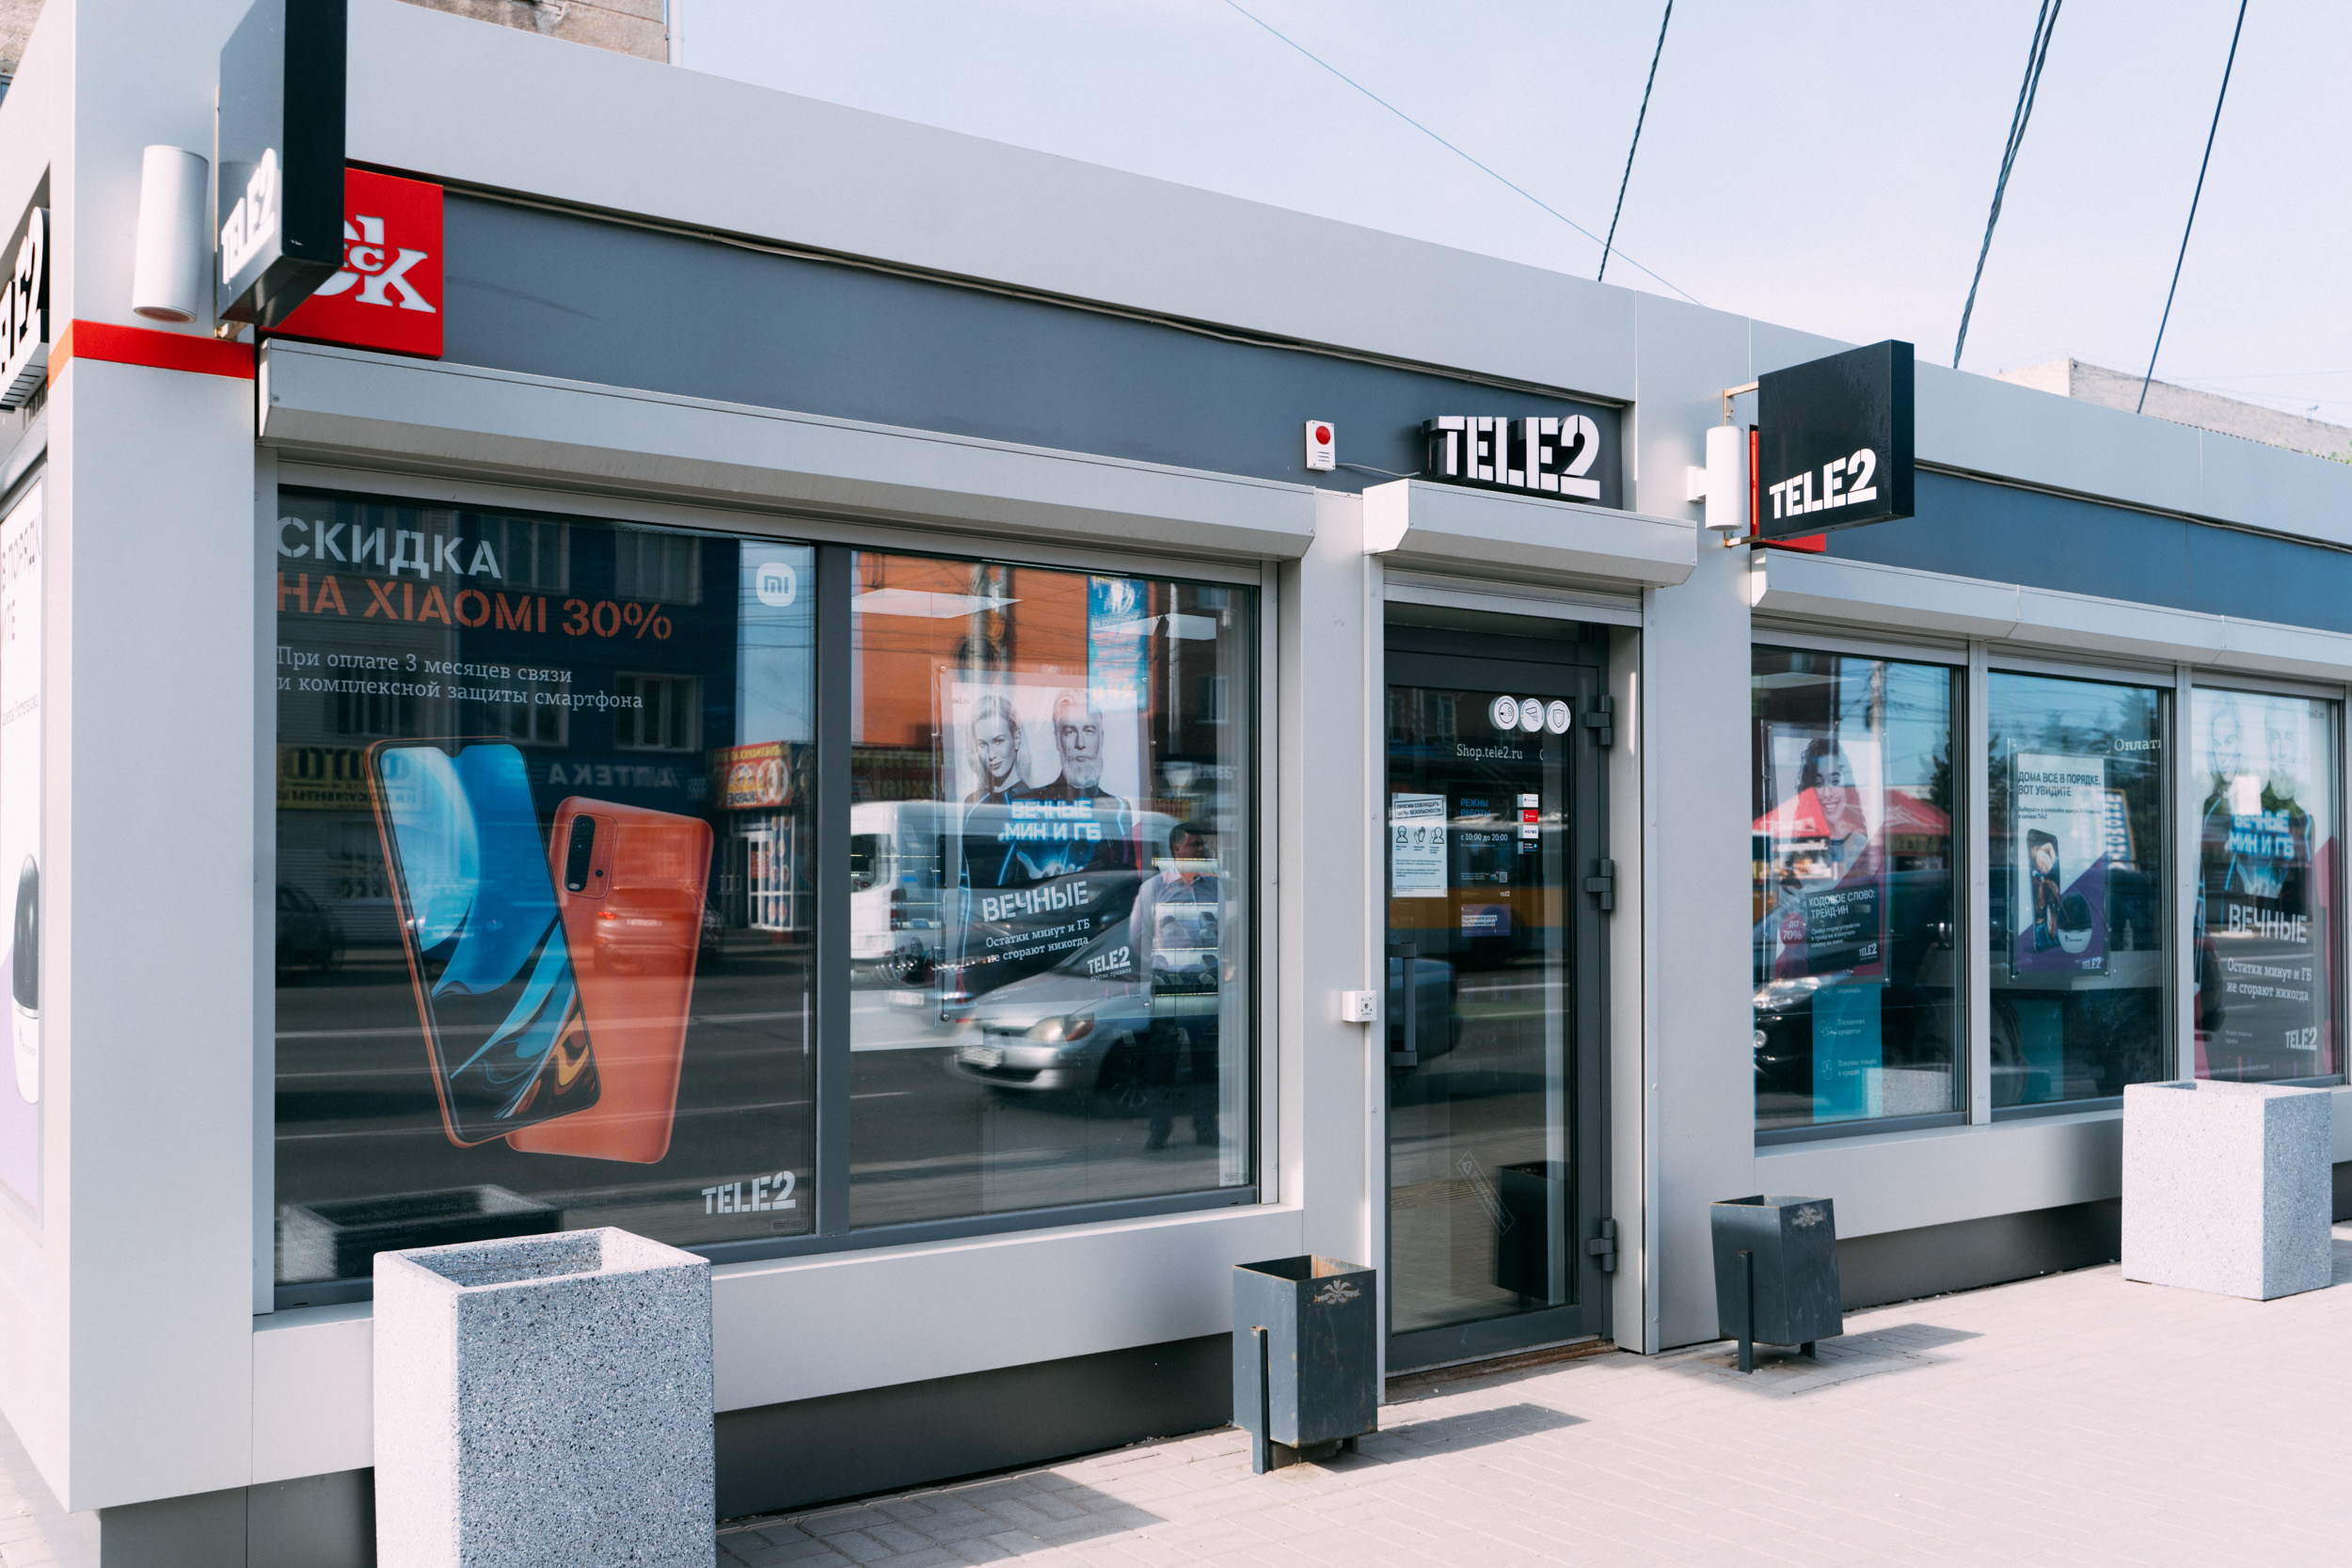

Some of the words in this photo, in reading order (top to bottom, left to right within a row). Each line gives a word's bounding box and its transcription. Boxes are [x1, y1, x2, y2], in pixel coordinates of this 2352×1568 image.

[220, 148, 276, 284] TELE2
[1436, 414, 1600, 500] TELE2
[1769, 448, 1877, 519] TELE2
[278, 516, 501, 579] СКИДКА
[278, 571, 349, 616] НА
[363, 578, 547, 633] XIAOMI
[562, 598, 673, 640] 30%
[278, 646, 321, 671] При
[326, 653, 399, 671] оплате
[405, 653, 418, 673] 3
[424, 660, 510, 680] месяцев
[517, 667, 572, 684] связи
[278, 676, 292, 690] и
[298, 678, 440, 698] комплексной
[448, 685, 528, 705] защиты
[534, 690, 644, 713] смартфона
[1456, 743, 1523, 761] Shop.tele2.ru
[2018, 771, 2042, 784] ДОМА
[2043, 772, 2058, 784] ВСЕ
[2060, 773, 2065, 784] В
[2067, 774, 2101, 786] ПОРЯДКЕ,
[1460, 799, 1488, 807] РЕЖИМ
[2018, 784, 2033, 795] ВОТ
[2036, 785, 2072, 798] УВИДИТЕ
[1010, 799, 1093, 820] ВЕЧНЫЕ
[1460, 809, 1491, 817] РАБОТЫ
[1004, 821, 1047, 841] МИН
[1053, 821, 1069, 841] И
[1073, 821, 1102, 841] ГБ
[1465, 832, 1482, 841] 10:00
[1483, 834, 1491, 843] до
[1491, 833, 1508, 842] 20:00
[2229, 831, 2258, 854] МИН
[2261, 834, 2273, 856] И
[2275, 835, 2295, 860] ГБ
[981, 880, 1089, 923] ВЕЧНЫЕ
[1809, 893, 1846, 908] КОДОВОЕ
[1848, 889, 1876, 902] СЛОВО:
[1811, 905, 1849, 919] ТРЕЙД-ИН
[2229, 903, 2308, 943] ВЕЧНЫЕ
[985, 931, 1029, 948] Остатки
[1032, 927, 1066, 941] минут
[1068, 924, 1075, 933] и
[1077, 918, 1090, 931] ГБ
[1783, 930, 1803, 941] 70%
[987, 954, 1000, 964] не
[1002, 945, 1045, 961] сгорают
[1048, 937, 1089, 952] никогда
[1087, 945, 1131, 974] TELE2
[1859, 942, 1877, 957] TELE2
[2082, 957, 2101, 970] TELE2
[2227, 958, 2262, 975] Остатки
[2265, 965, 2292, 982] минут
[2294, 970, 2299, 980] и
[2301, 967, 2312, 982] ГБ
[2227, 982, 2236, 992] не
[2239, 984, 2274, 999] сгорают
[2276, 988, 2309, 1002] никогда
[2285, 1026, 2317, 1051] TELE2
[702, 1170, 797, 1214] TELE2
